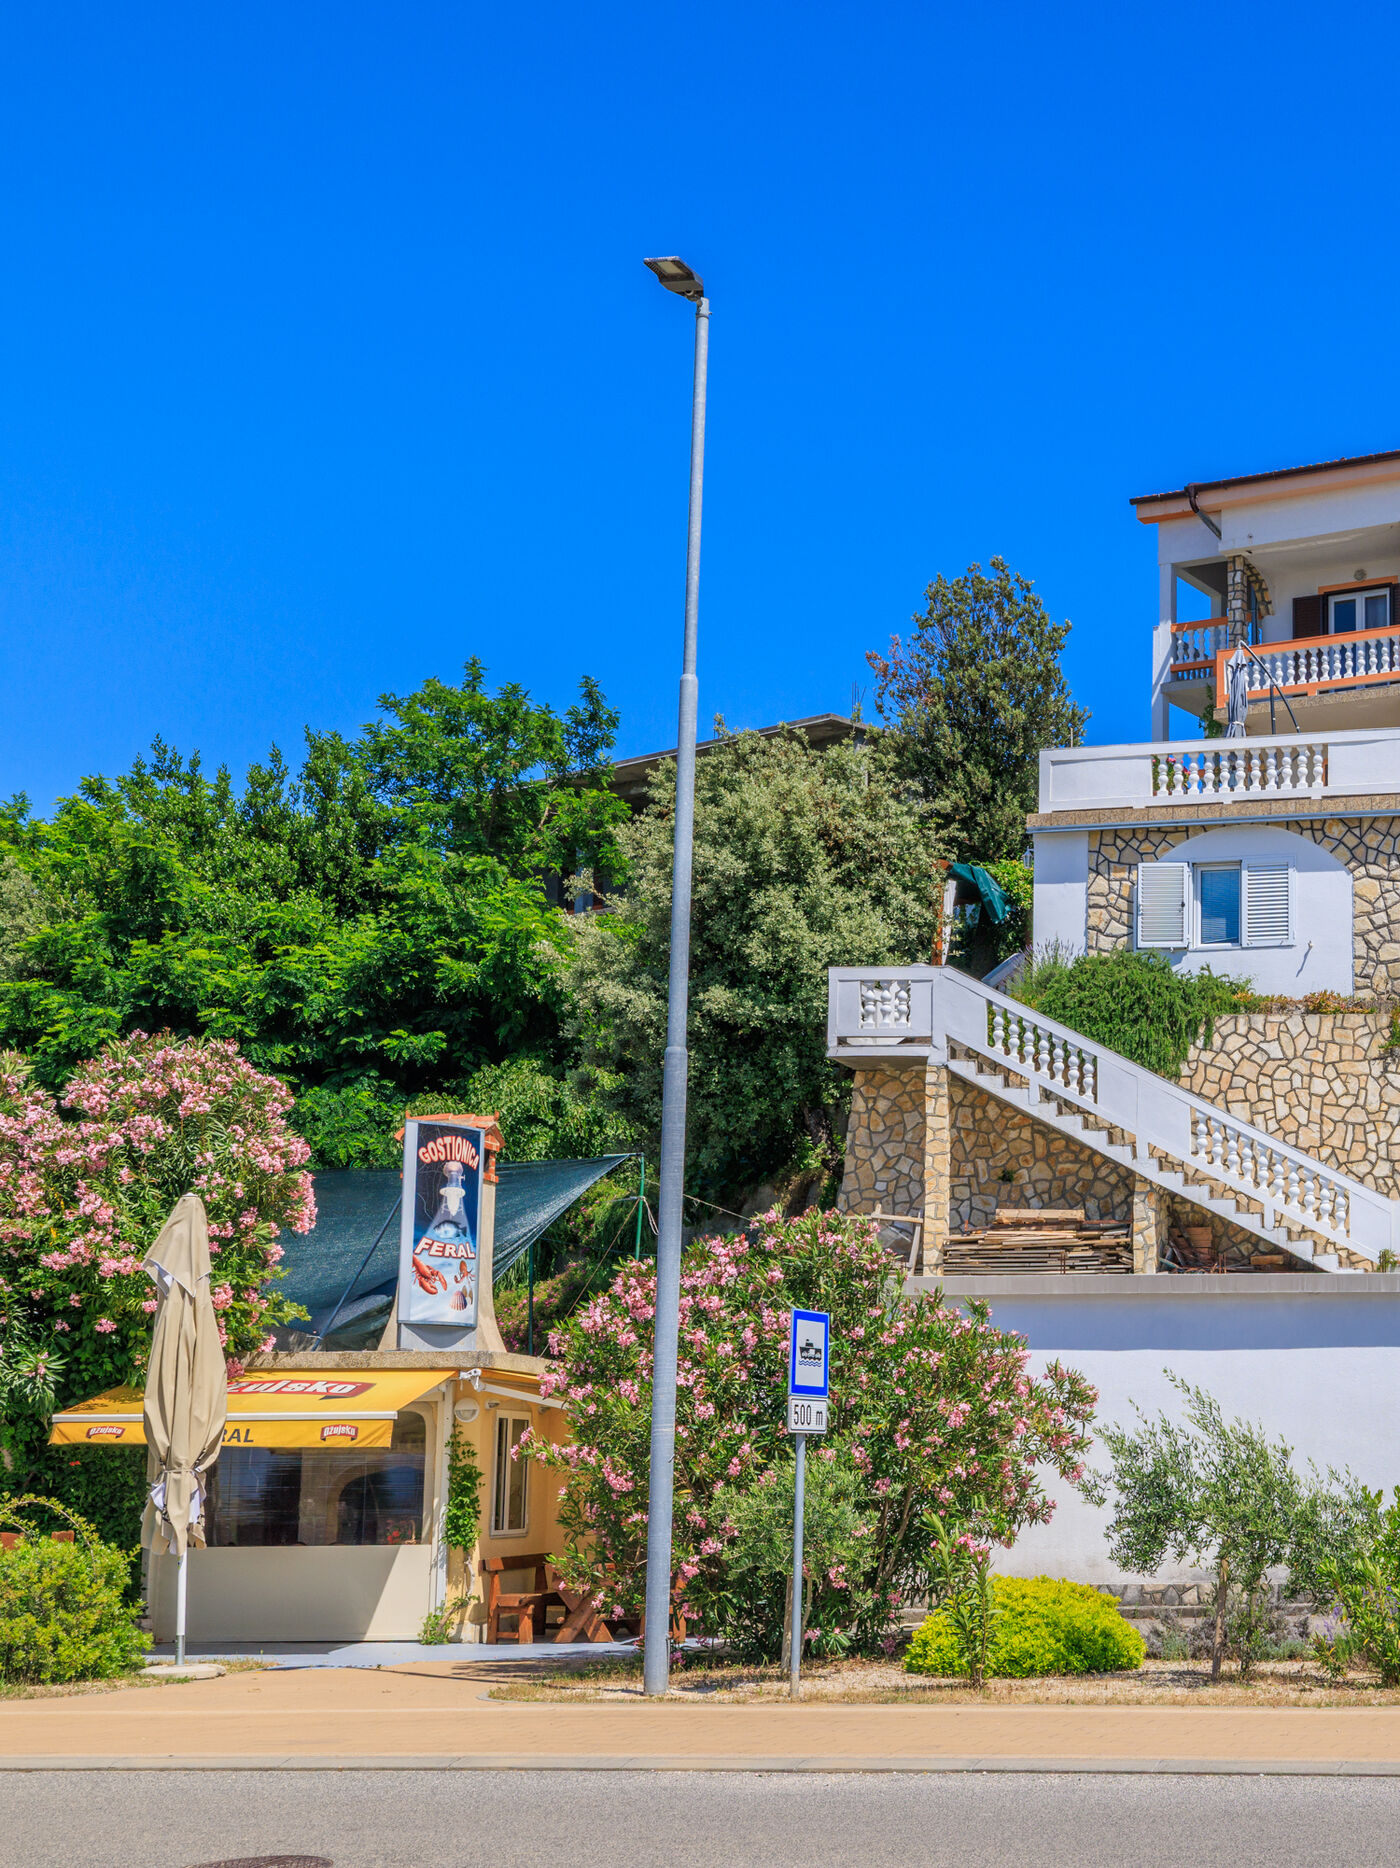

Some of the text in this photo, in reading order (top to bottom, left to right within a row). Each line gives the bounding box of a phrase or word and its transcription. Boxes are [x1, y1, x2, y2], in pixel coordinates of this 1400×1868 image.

[418, 1135, 480, 1170] GOSTIONICA
[414, 1236, 476, 1259] FERAL
[226, 1380, 357, 1393] žujsko
[793, 1404, 823, 1425] 500 m
